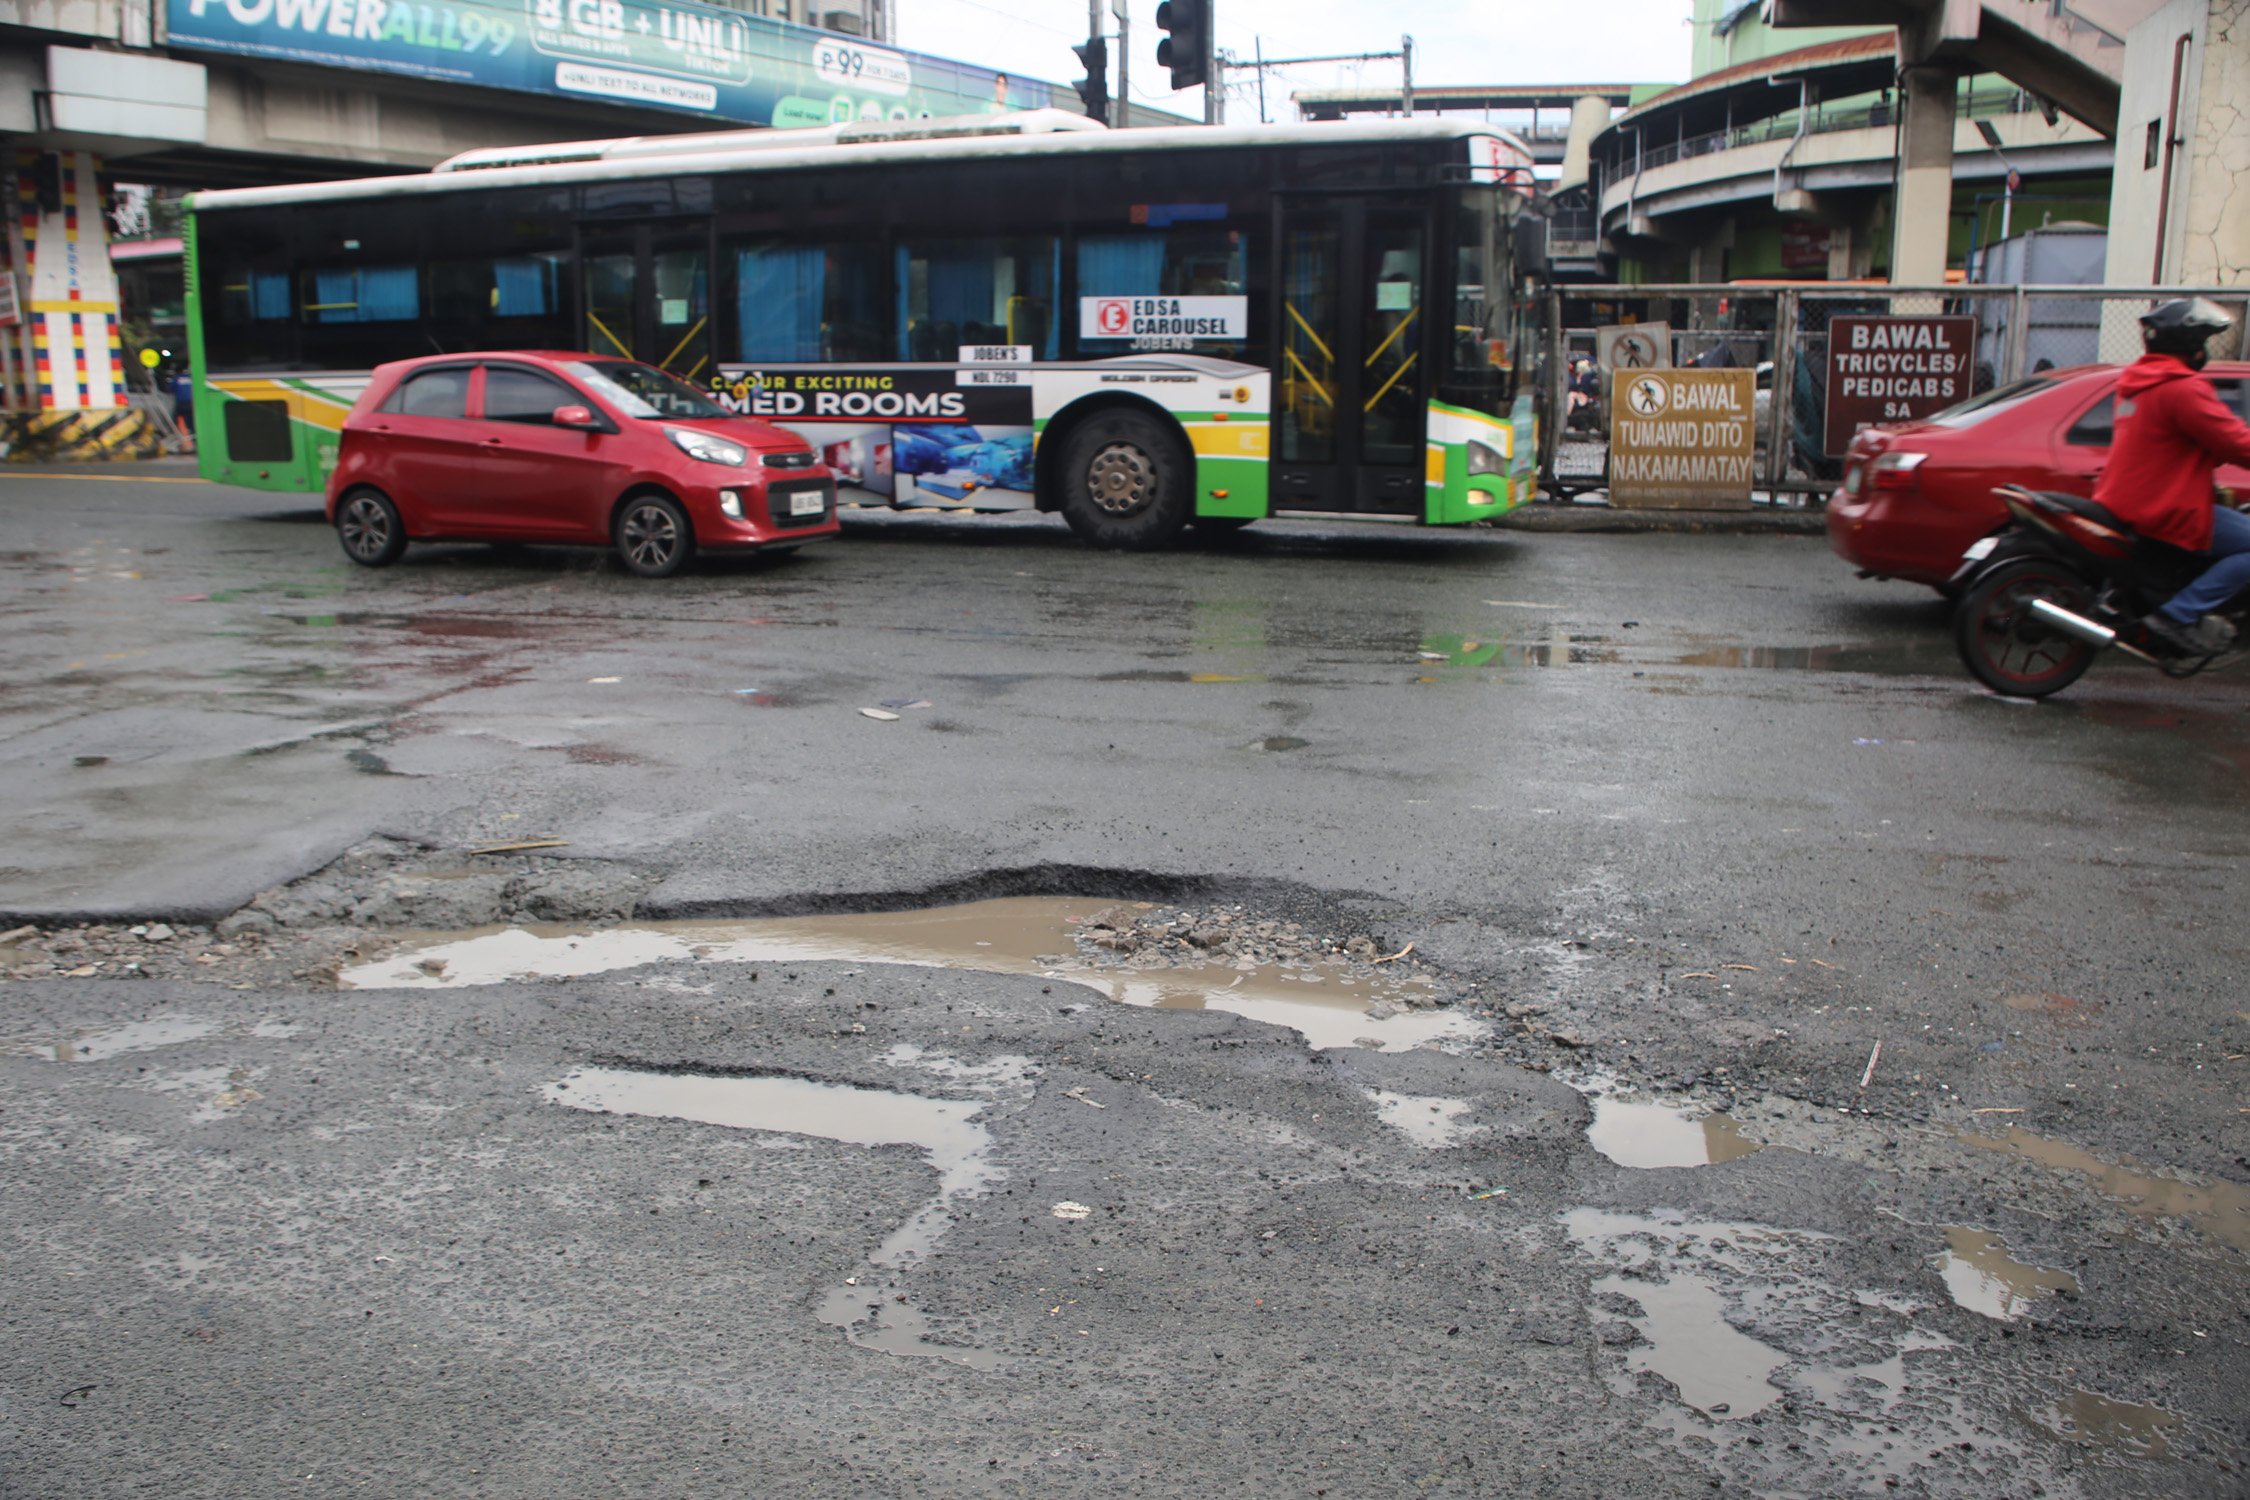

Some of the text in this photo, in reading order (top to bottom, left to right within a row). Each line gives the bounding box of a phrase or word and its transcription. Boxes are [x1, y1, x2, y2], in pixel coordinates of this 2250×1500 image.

[569, 0, 626, 40] GB
[660, 8, 742, 63] UNLI
[838, 48, 863, 77] 99
[1133, 300, 1181, 316] EDSA
[1133, 318, 1228, 335] CAROUSEL
[1852, 325, 1951, 349] BAWAL
[1836, 353, 1967, 373] TRICYCLES/
[795, 376, 894, 390] EXCITING
[1842, 378, 1955, 397] PEDICABS
[815, 391, 966, 417] ROOMS
[1672, 383, 1742, 411] BAWAL
[1884, 402, 1912, 418] SA
[1619, 420, 1743, 450] TUMAWID DITO
[1612, 454, 1751, 483] NAKAMAMATAY
